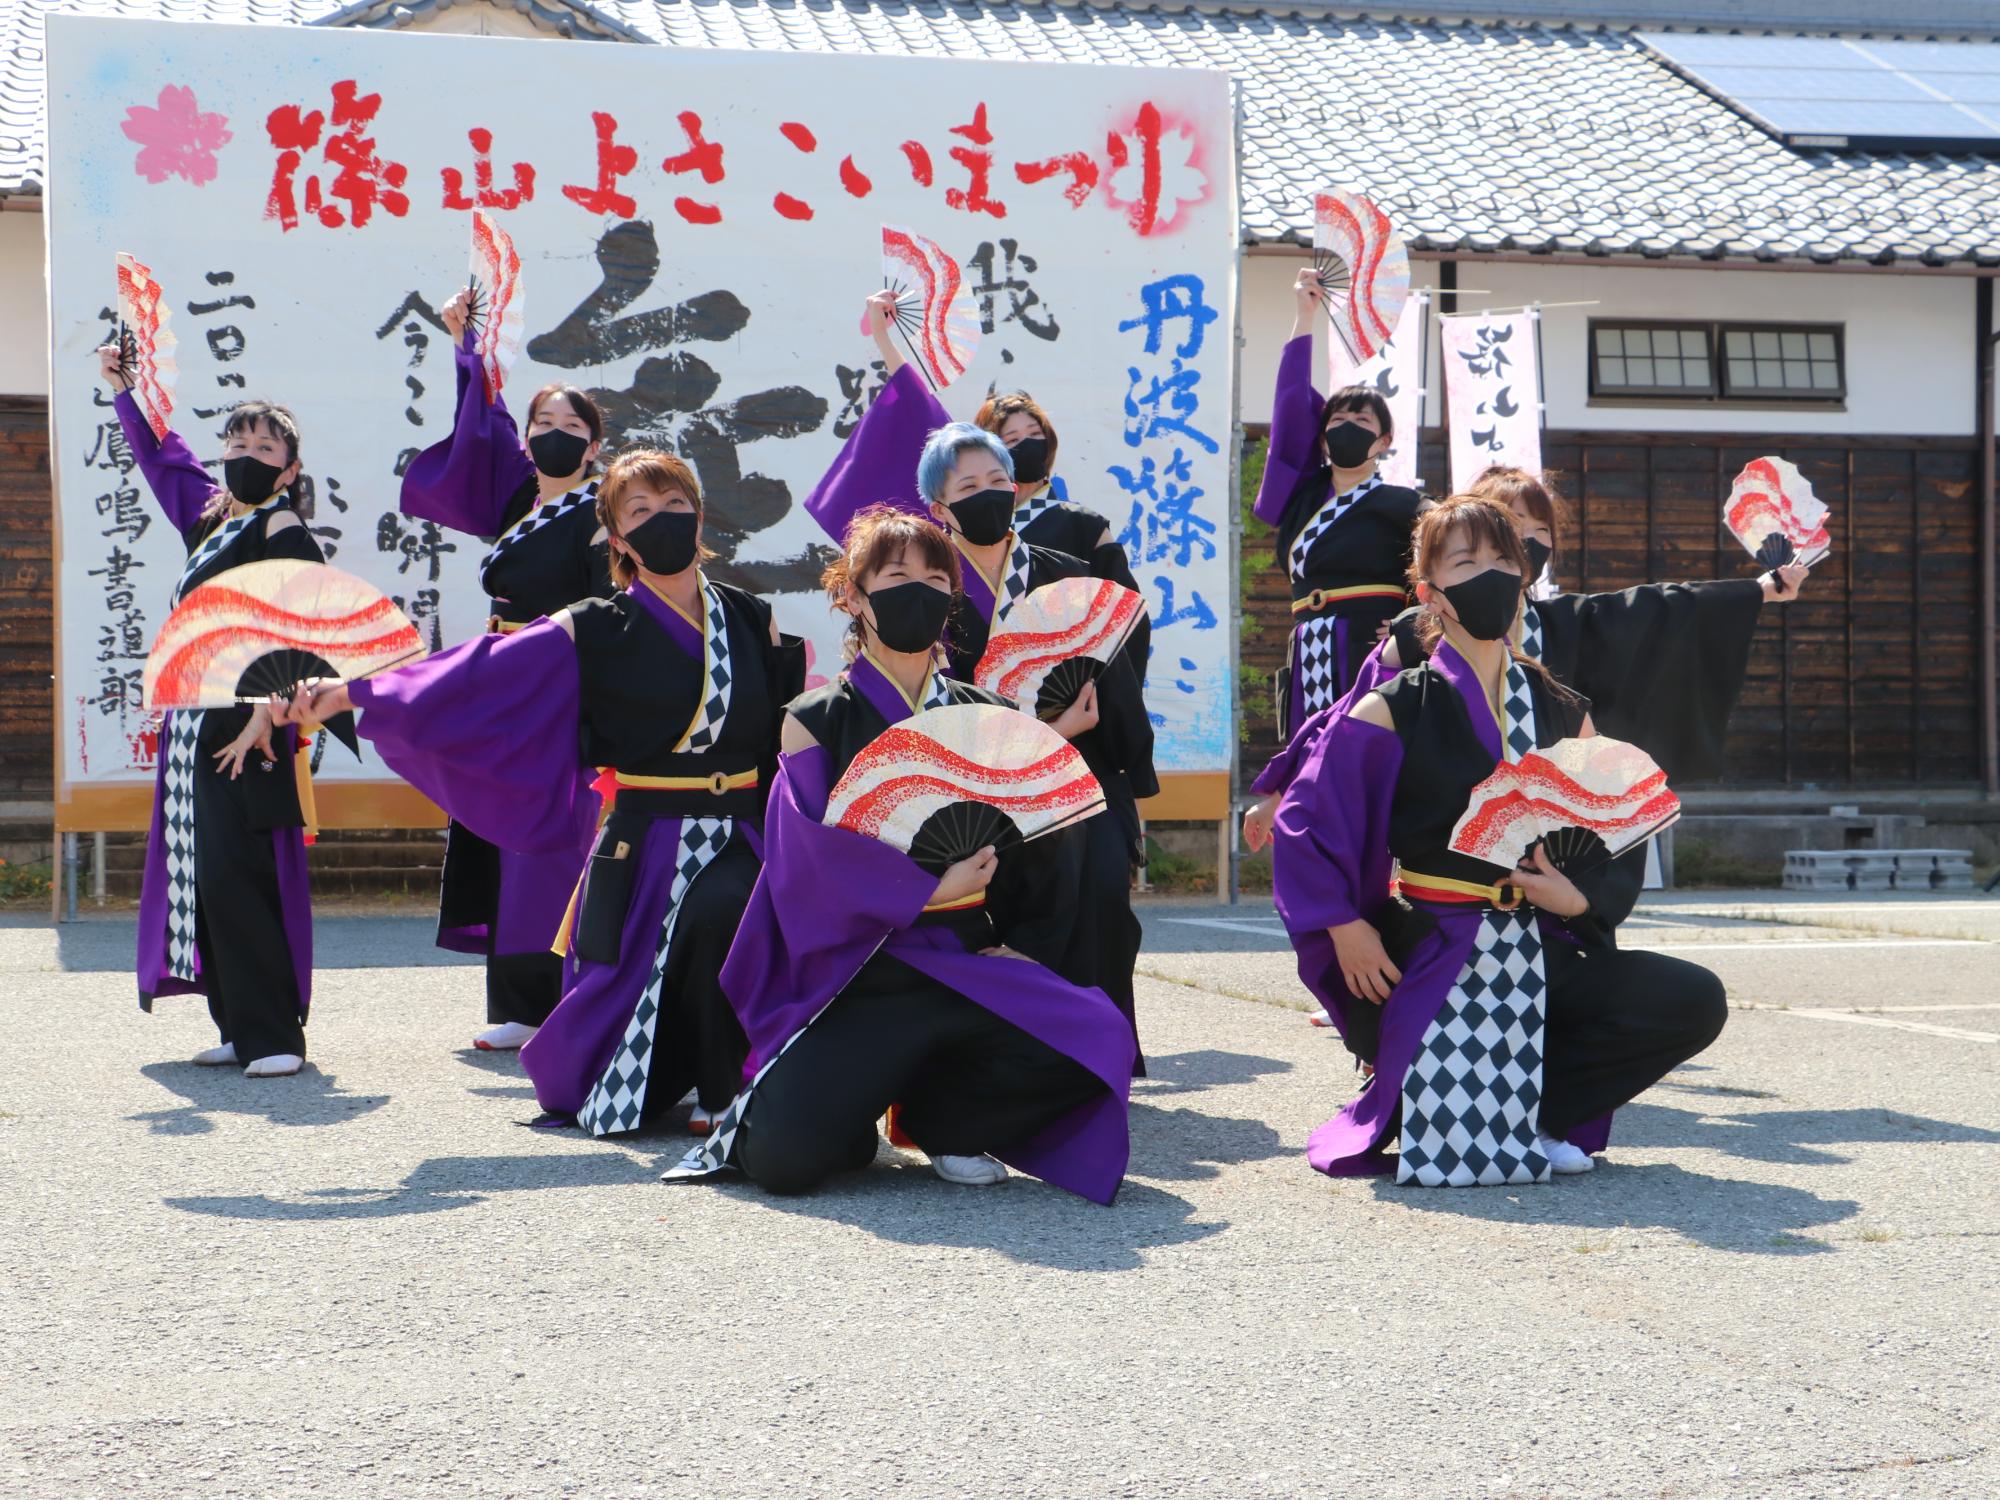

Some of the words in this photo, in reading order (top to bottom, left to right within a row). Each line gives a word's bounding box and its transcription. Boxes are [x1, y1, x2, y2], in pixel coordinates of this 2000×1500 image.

[265, 79, 1162, 235] 篠山よさこいまつり
[967, 238, 1060, 364] 我
[1107, 274, 1219, 727] 丹波篠山に
